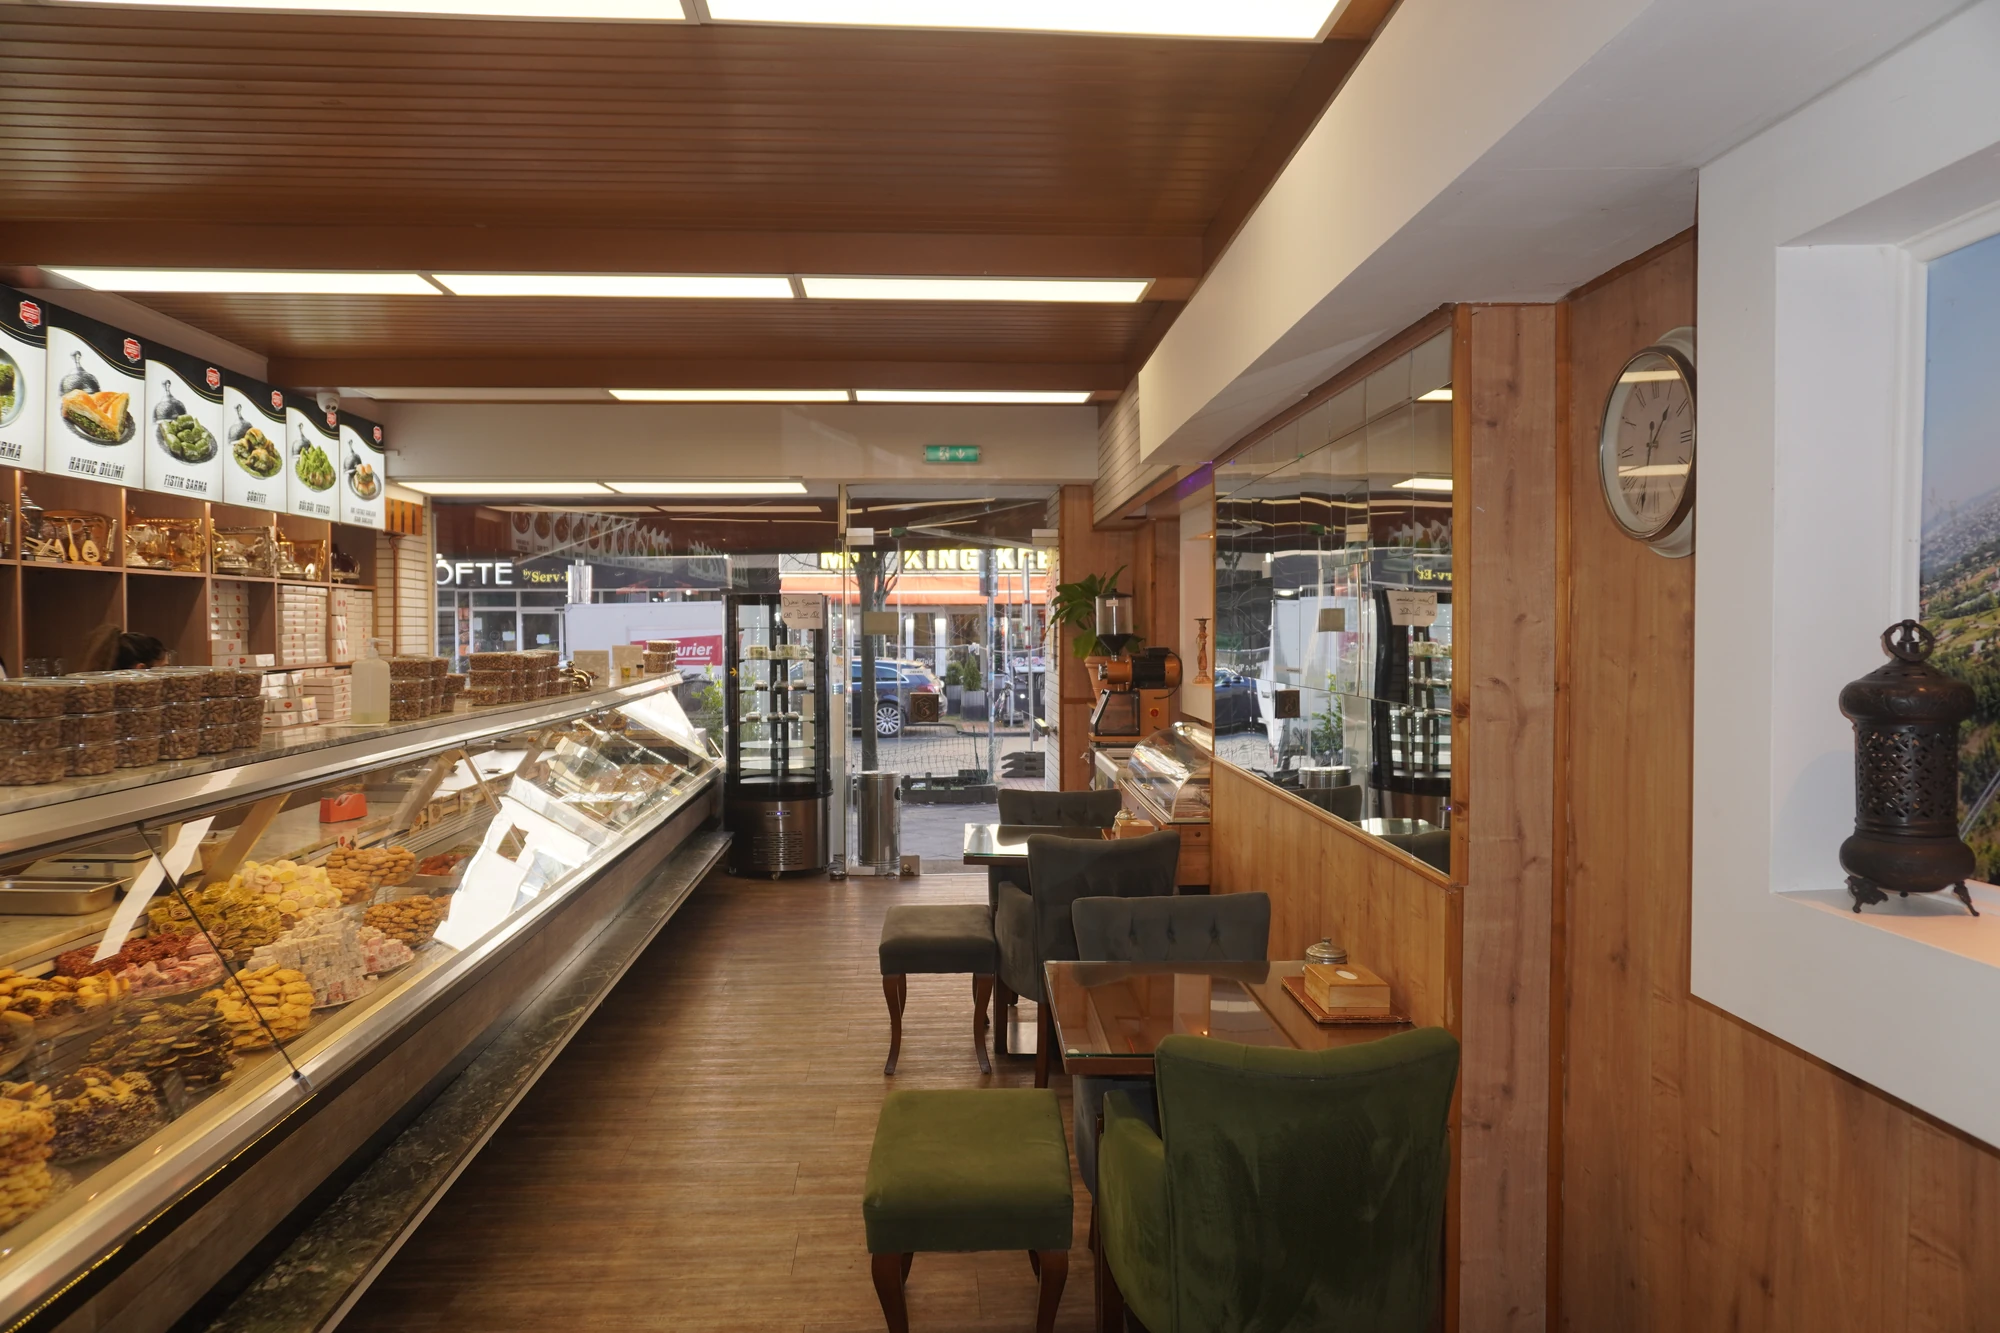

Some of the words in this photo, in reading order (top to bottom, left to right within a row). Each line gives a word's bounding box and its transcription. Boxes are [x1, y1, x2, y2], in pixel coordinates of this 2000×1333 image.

[0, 441, 22, 459] RMA
[903, 549, 978, 570] KING
[675, 643, 713, 657] urier
